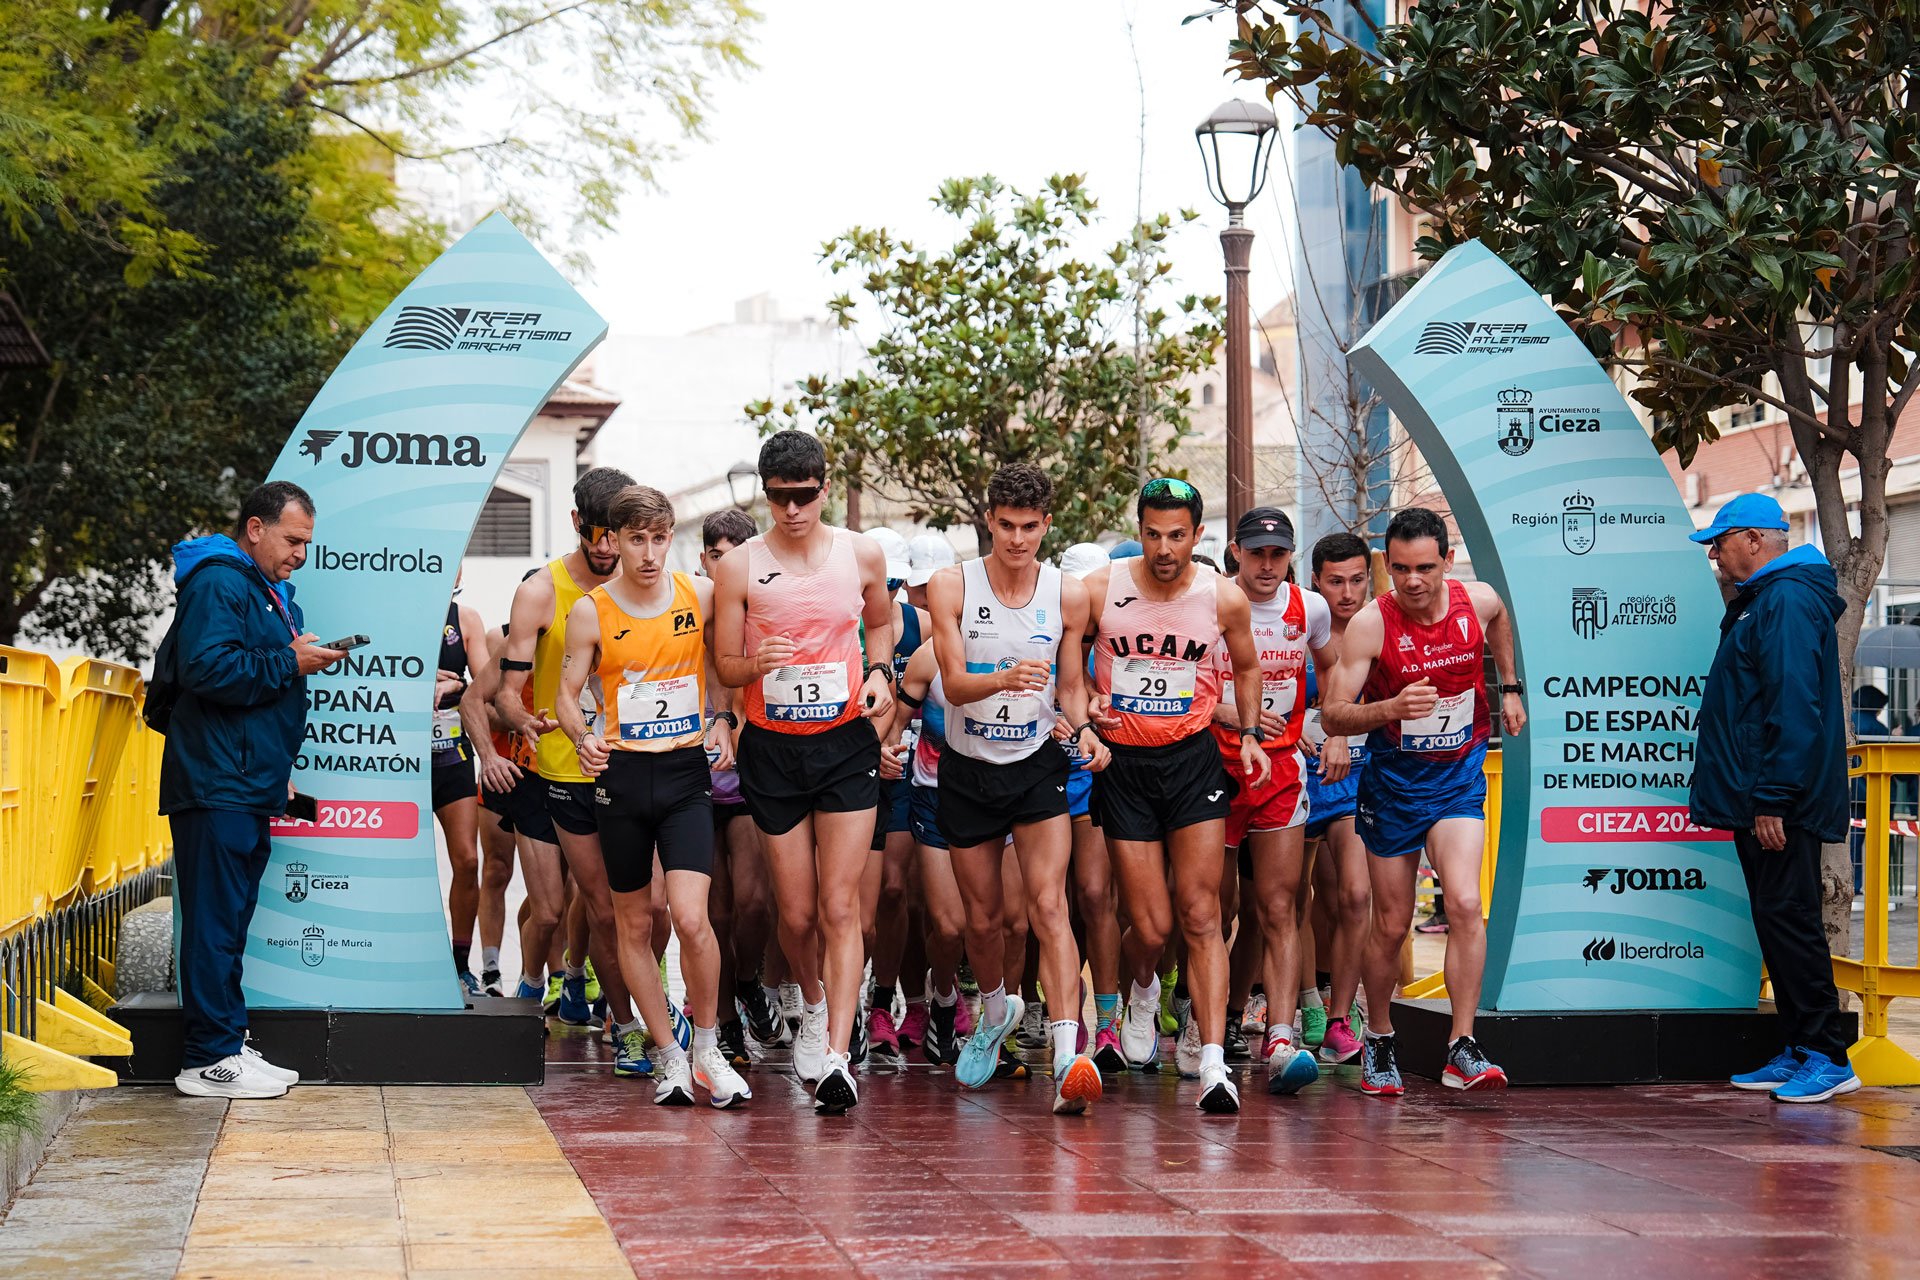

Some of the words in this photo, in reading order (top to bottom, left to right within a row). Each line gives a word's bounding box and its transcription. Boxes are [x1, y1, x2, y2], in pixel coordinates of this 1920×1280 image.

[471, 311, 542, 327] RFEA
[464, 328, 572, 341] ATLETISMO
[1477, 323, 1528, 335] RFEA
[457, 341, 522, 353] MARCHA
[1472, 336, 1550, 344] ATLETISMO
[1467, 346, 1514, 355] MARCHA
[1539, 414, 1601, 433] Cieza
[341, 431, 487, 468] Joma
[1512, 513, 1558, 528] Región
[1599, 513, 1616, 525] de
[1620, 513, 1666, 525] Murcia
[315, 545, 443, 574] Iberdrola
[1619, 599, 1676, 614] murcia
[1626, 594, 1657, 605] región
[1663, 594, 1676, 603] de
[674, 612, 696, 632] PA
[1611, 614, 1677, 625] ATLETISMO
[1109, 633, 1208, 662] UCAM
[311, 655, 424, 678] ONATO
[1401, 664, 1421, 673] A.D.
[1423, 652, 1475, 671] MARATHON
[793, 683, 820, 703] 13
[1139, 677, 1167, 697] 29
[655, 700, 669, 719] 2
[789, 704, 839, 720] Joma
[996, 704, 1010, 723] 4
[1133, 698, 1184, 713] Joma
[644, 718, 693, 738] Joma
[1438, 715, 1450, 733] 7
[1565, 710, 1600, 732] DE
[303, 722, 397, 745] ARCHA
[1425, 729, 1466, 749] Joma
[1563, 742, 1596, 763] DE
[1601, 742, 1694, 762] MARCH
[314, 753, 420, 773] MARATÓN
[1544, 773, 1568, 789] DE
[1573, 773, 1637, 789] MEDIO
[319, 807, 383, 829] 2026
[1577, 812, 1651, 833] CIEZA
[311, 878, 349, 890] Cieza
[1610, 868, 1707, 895] Joma
[267, 938, 299, 948] Región
[327, 939, 339, 947] de
[341, 939, 373, 948] Murcia
[1620, 941, 1704, 959] Iberdrola
[209, 1065, 240, 1081] RUN
